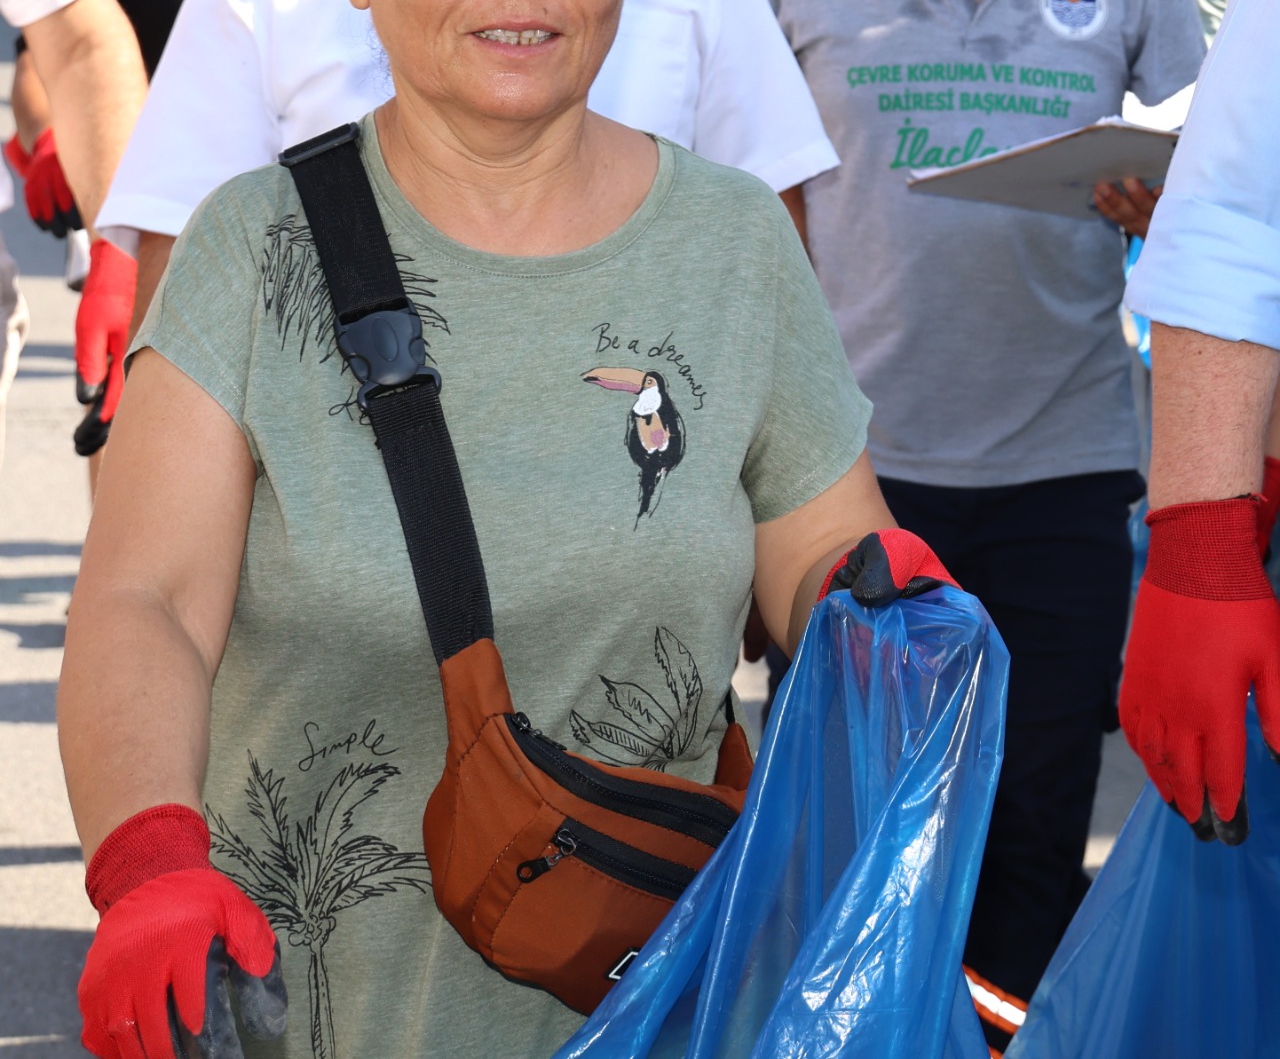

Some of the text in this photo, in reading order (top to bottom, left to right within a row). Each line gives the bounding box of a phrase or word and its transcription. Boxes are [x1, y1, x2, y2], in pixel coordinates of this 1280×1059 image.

[847, 63, 1097, 93] ÇEVRE KORUMA VE KONTROL
[878, 88, 1072, 118] DAİRESİ BAŞKANLIĞI
[591, 322, 621, 353] Be
[627, 339, 640, 354] a
[298, 718, 400, 772] Simple
